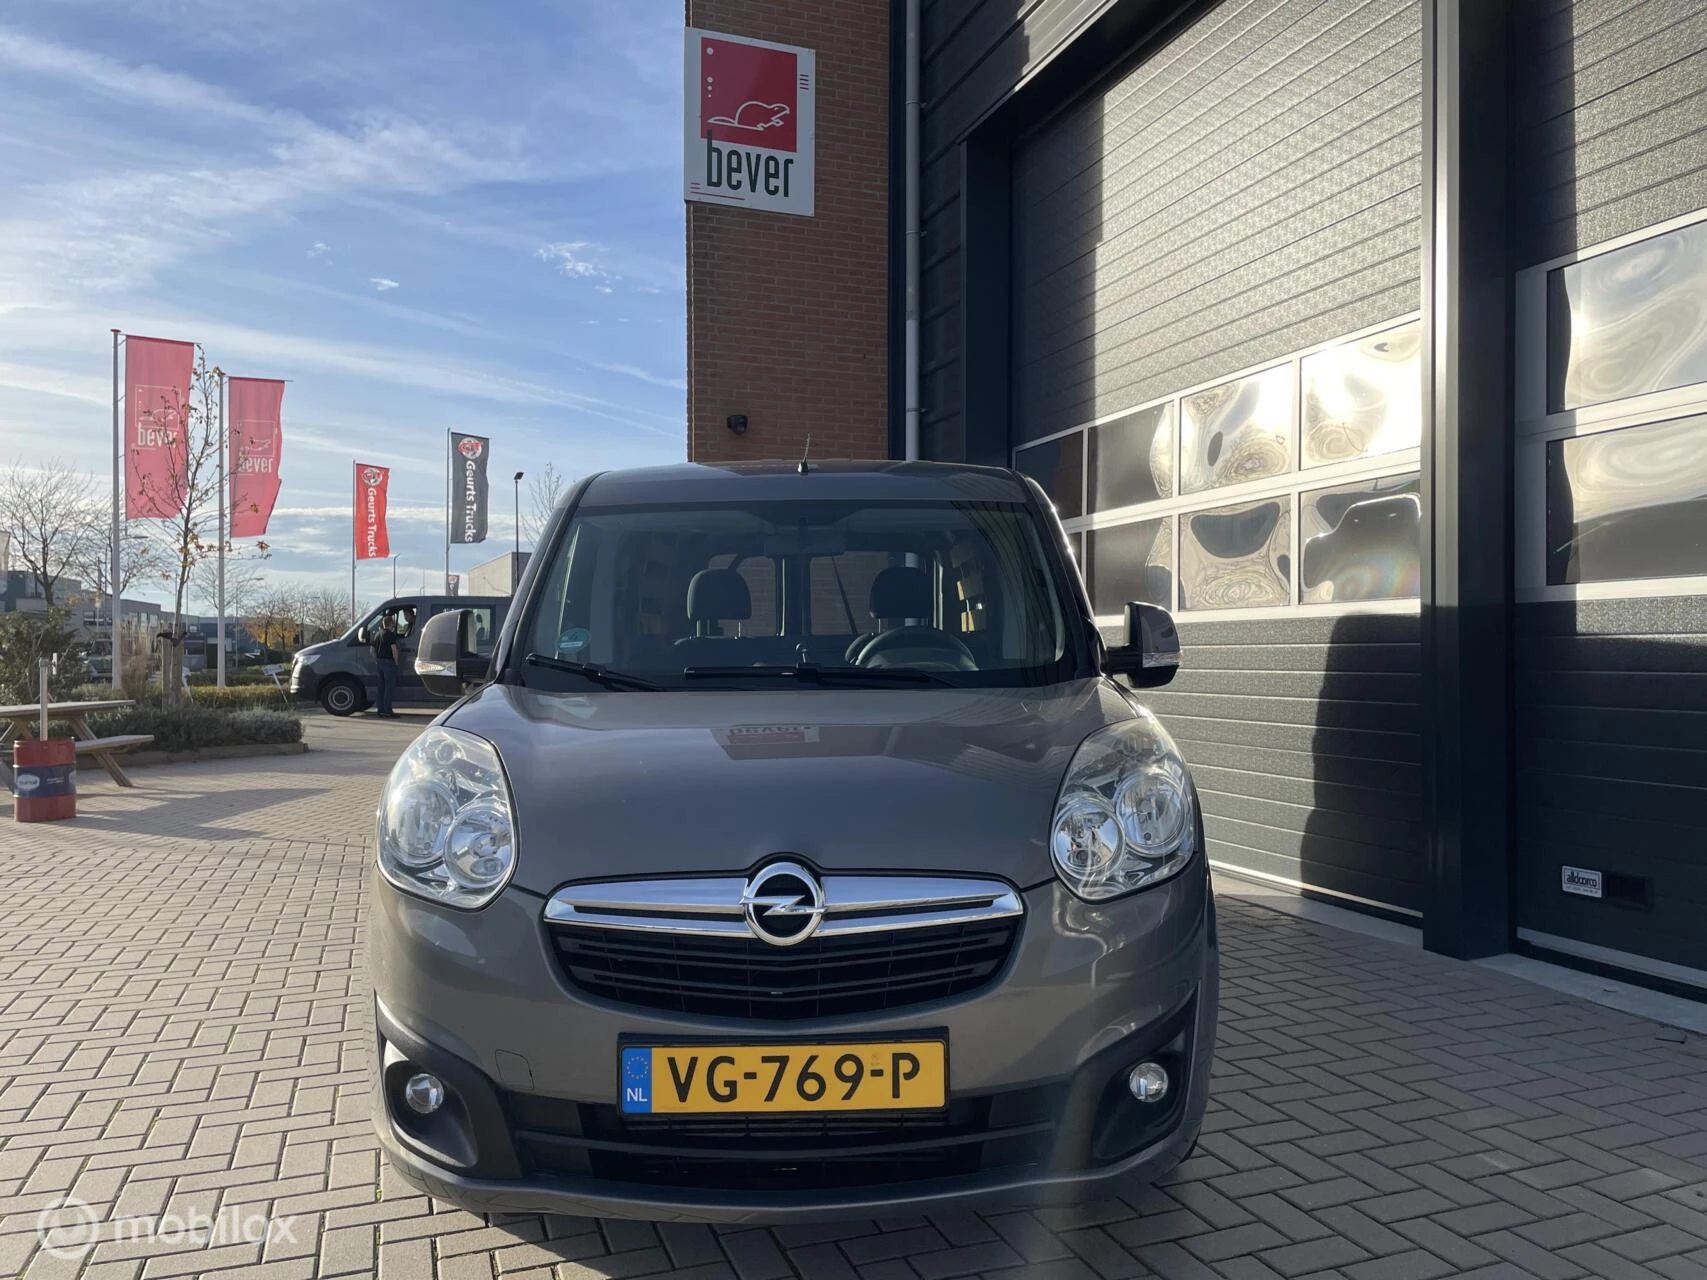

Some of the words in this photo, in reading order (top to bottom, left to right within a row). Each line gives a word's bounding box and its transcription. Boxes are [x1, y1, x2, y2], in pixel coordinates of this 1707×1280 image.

[706, 129, 793, 197] bever
[138, 421, 177, 448] bever
[465, 460, 476, 501] Geurts
[367, 487, 377, 523] Geurts
[464, 503, 477, 542] Trucks
[367, 524, 377, 557] Trucks
[626, 1087, 648, 1102] NL
[667, 1052, 920, 1103] VG-769-P
